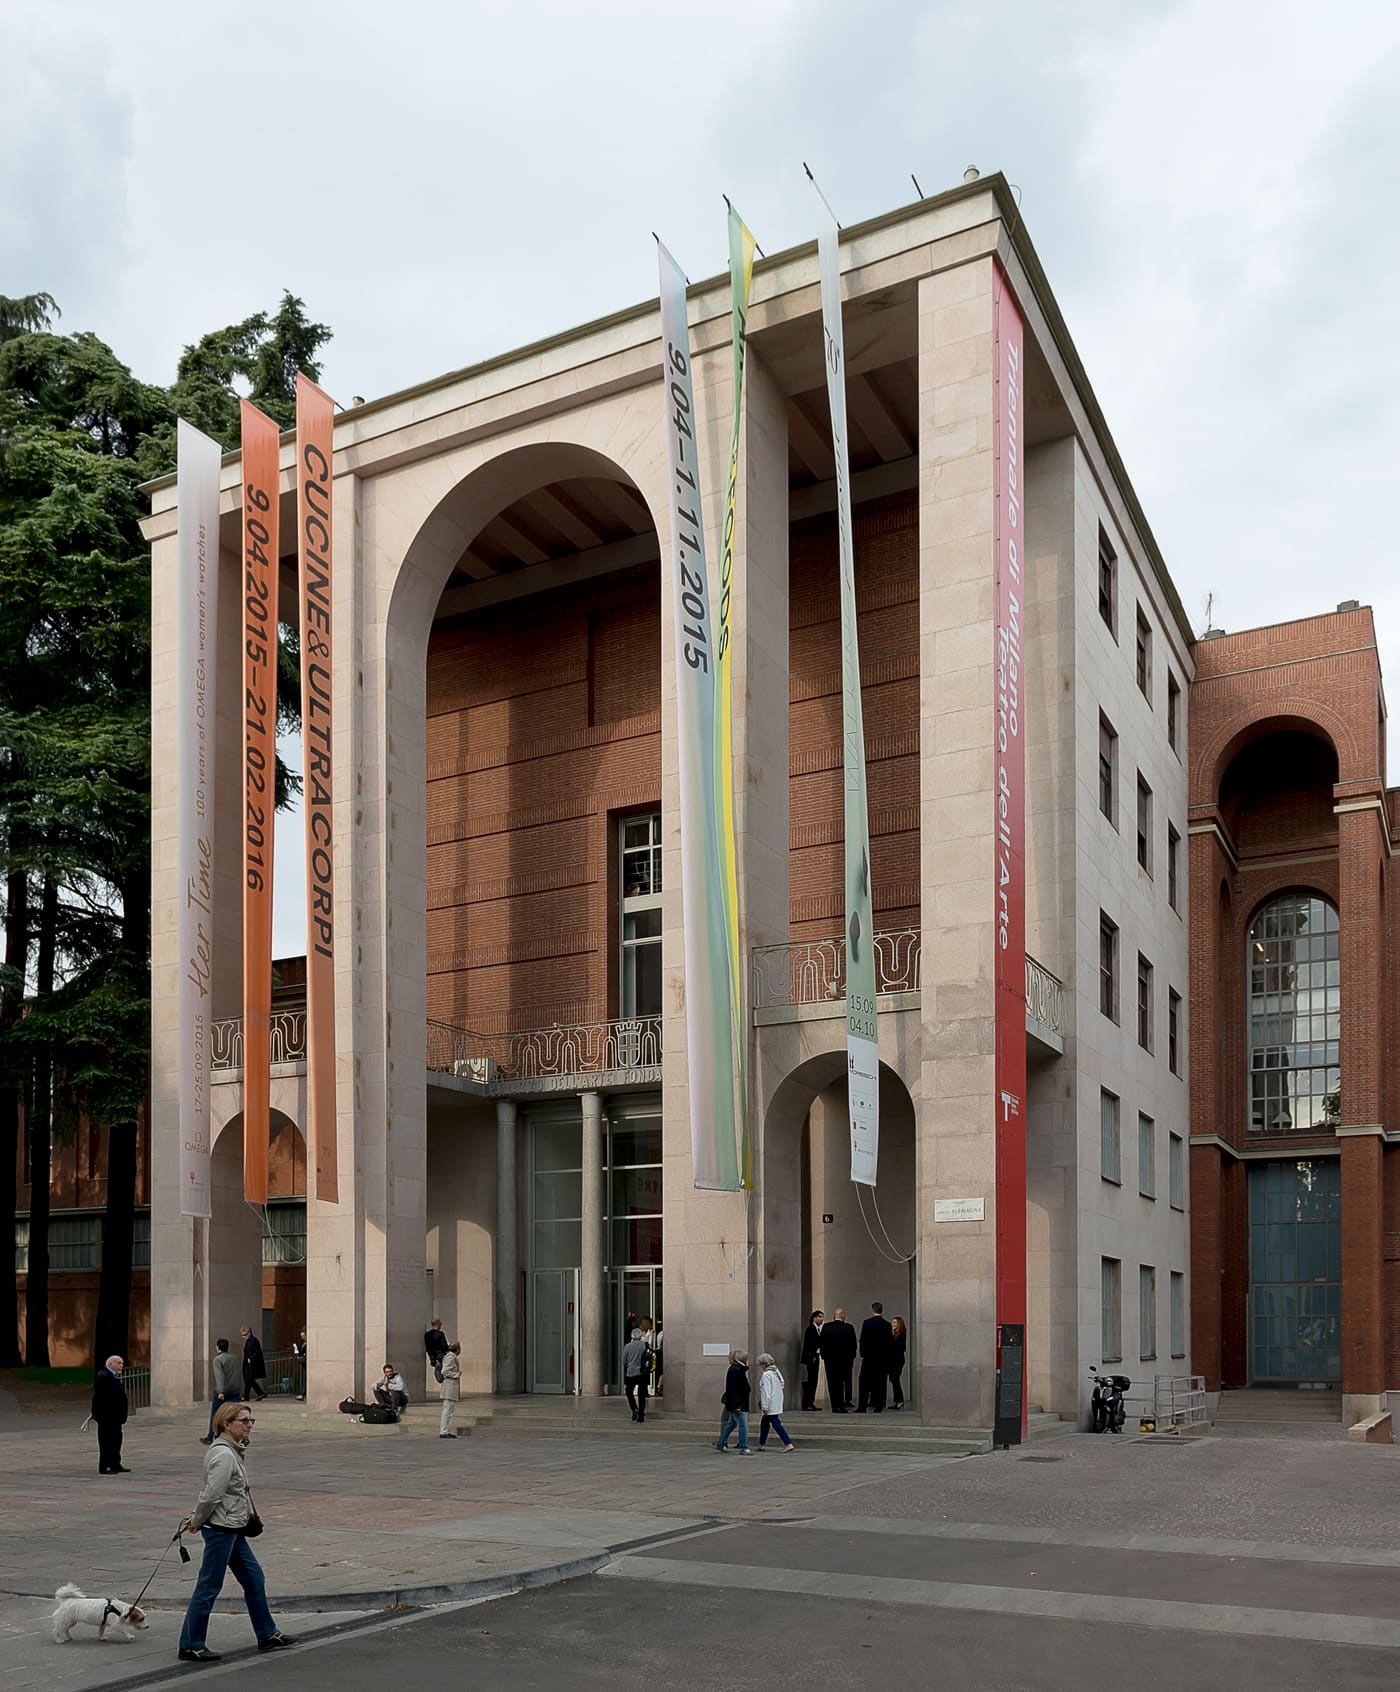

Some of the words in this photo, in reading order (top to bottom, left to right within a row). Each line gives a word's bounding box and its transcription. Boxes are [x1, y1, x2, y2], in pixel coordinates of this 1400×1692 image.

[1007, 340, 1019, 529] Triennale
[197, 524, 207, 583] watches
[1008, 538, 1020, 585] di
[196, 590, 207, 652] women's
[196, 658, 206, 719] OMEGA
[1008, 592, 1020, 737] Milano
[303, 442, 333, 959] CUCINE&ULTRACORPI
[196, 723, 206, 740] of
[196, 746, 206, 787] years
[196, 790, 206, 818] 100
[187, 836, 212, 914] Time
[999, 766, 1010, 950] dell'Arte
[187, 923, 211, 999] Her
[849, 1016, 876, 1038] 04.10
[850, 994, 874, 1015] 15.09
[195, 1014, 205, 1115] 17-25.09.2015
[184, 1141, 209, 1154] OMEGA
